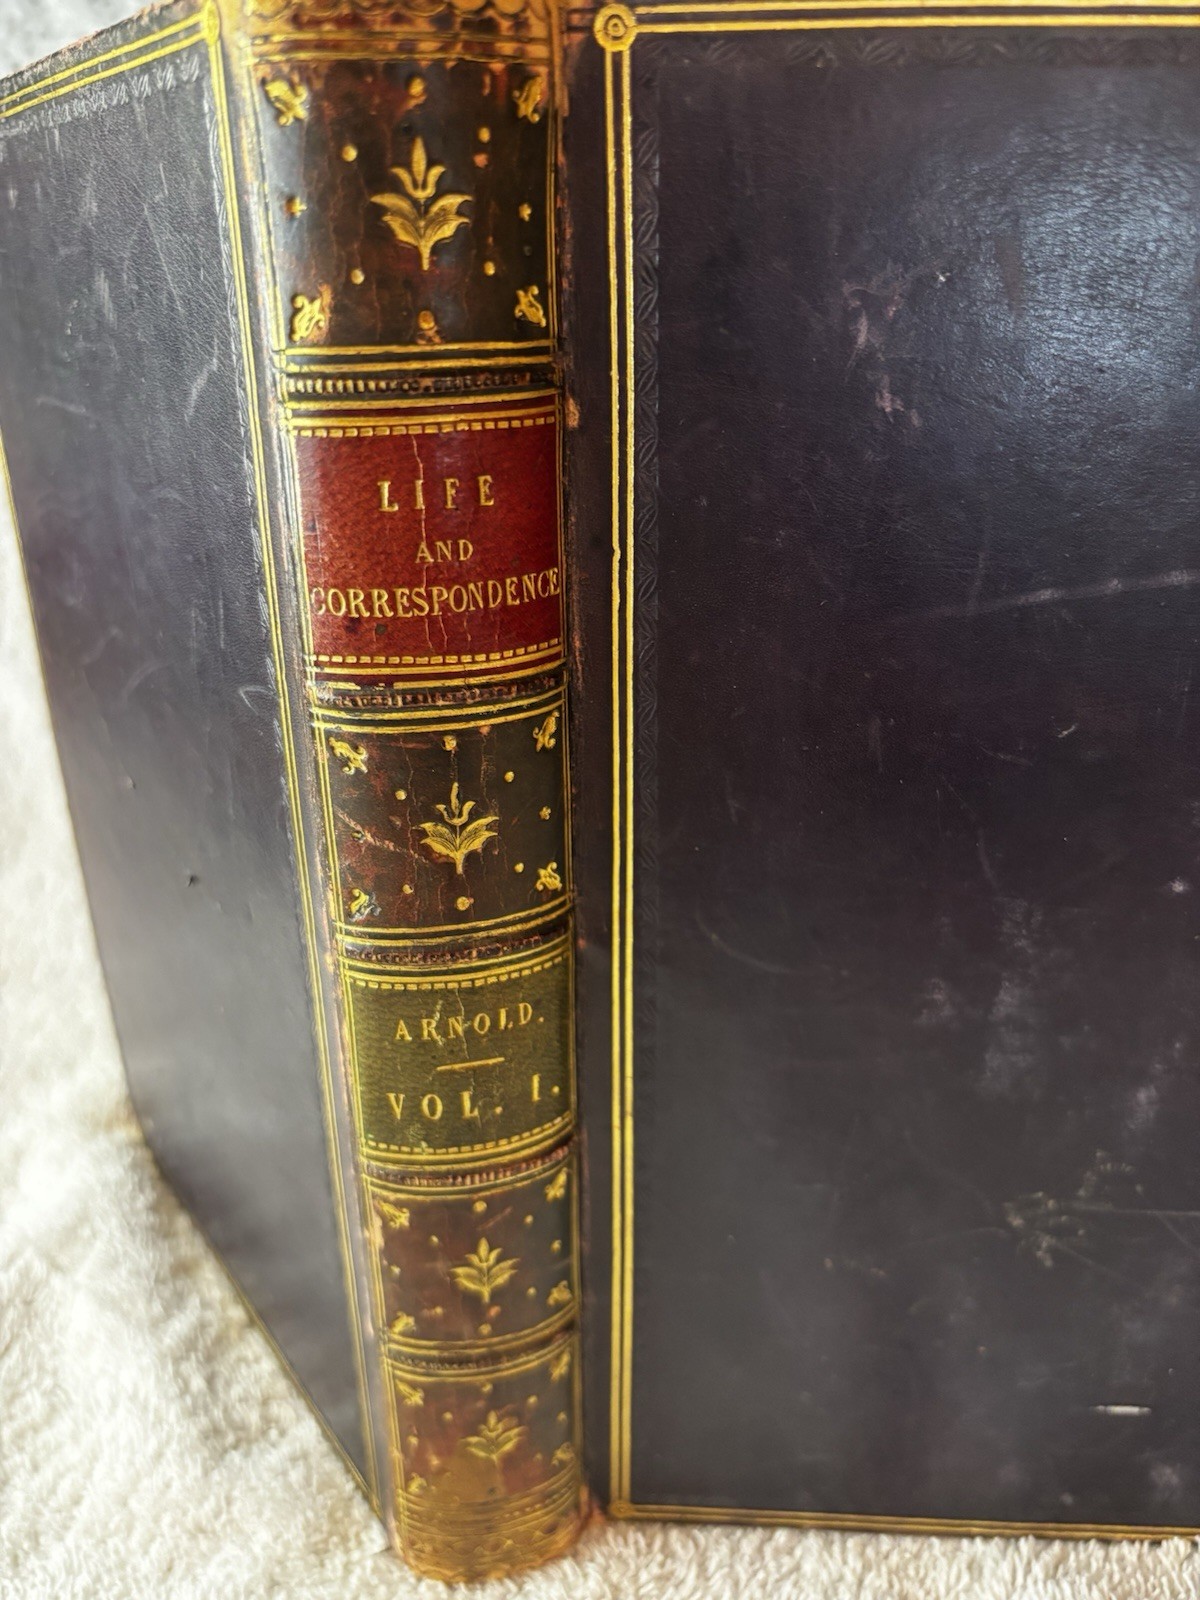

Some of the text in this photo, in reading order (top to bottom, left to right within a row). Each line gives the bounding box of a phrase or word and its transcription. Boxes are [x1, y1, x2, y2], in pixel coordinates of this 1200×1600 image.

[377, 475, 495, 512] LIFE
[415, 539, 474, 563] AND
[310, 567, 560, 618] CORRESPONDENCE
[387, 1090, 503, 1120] VOL.
